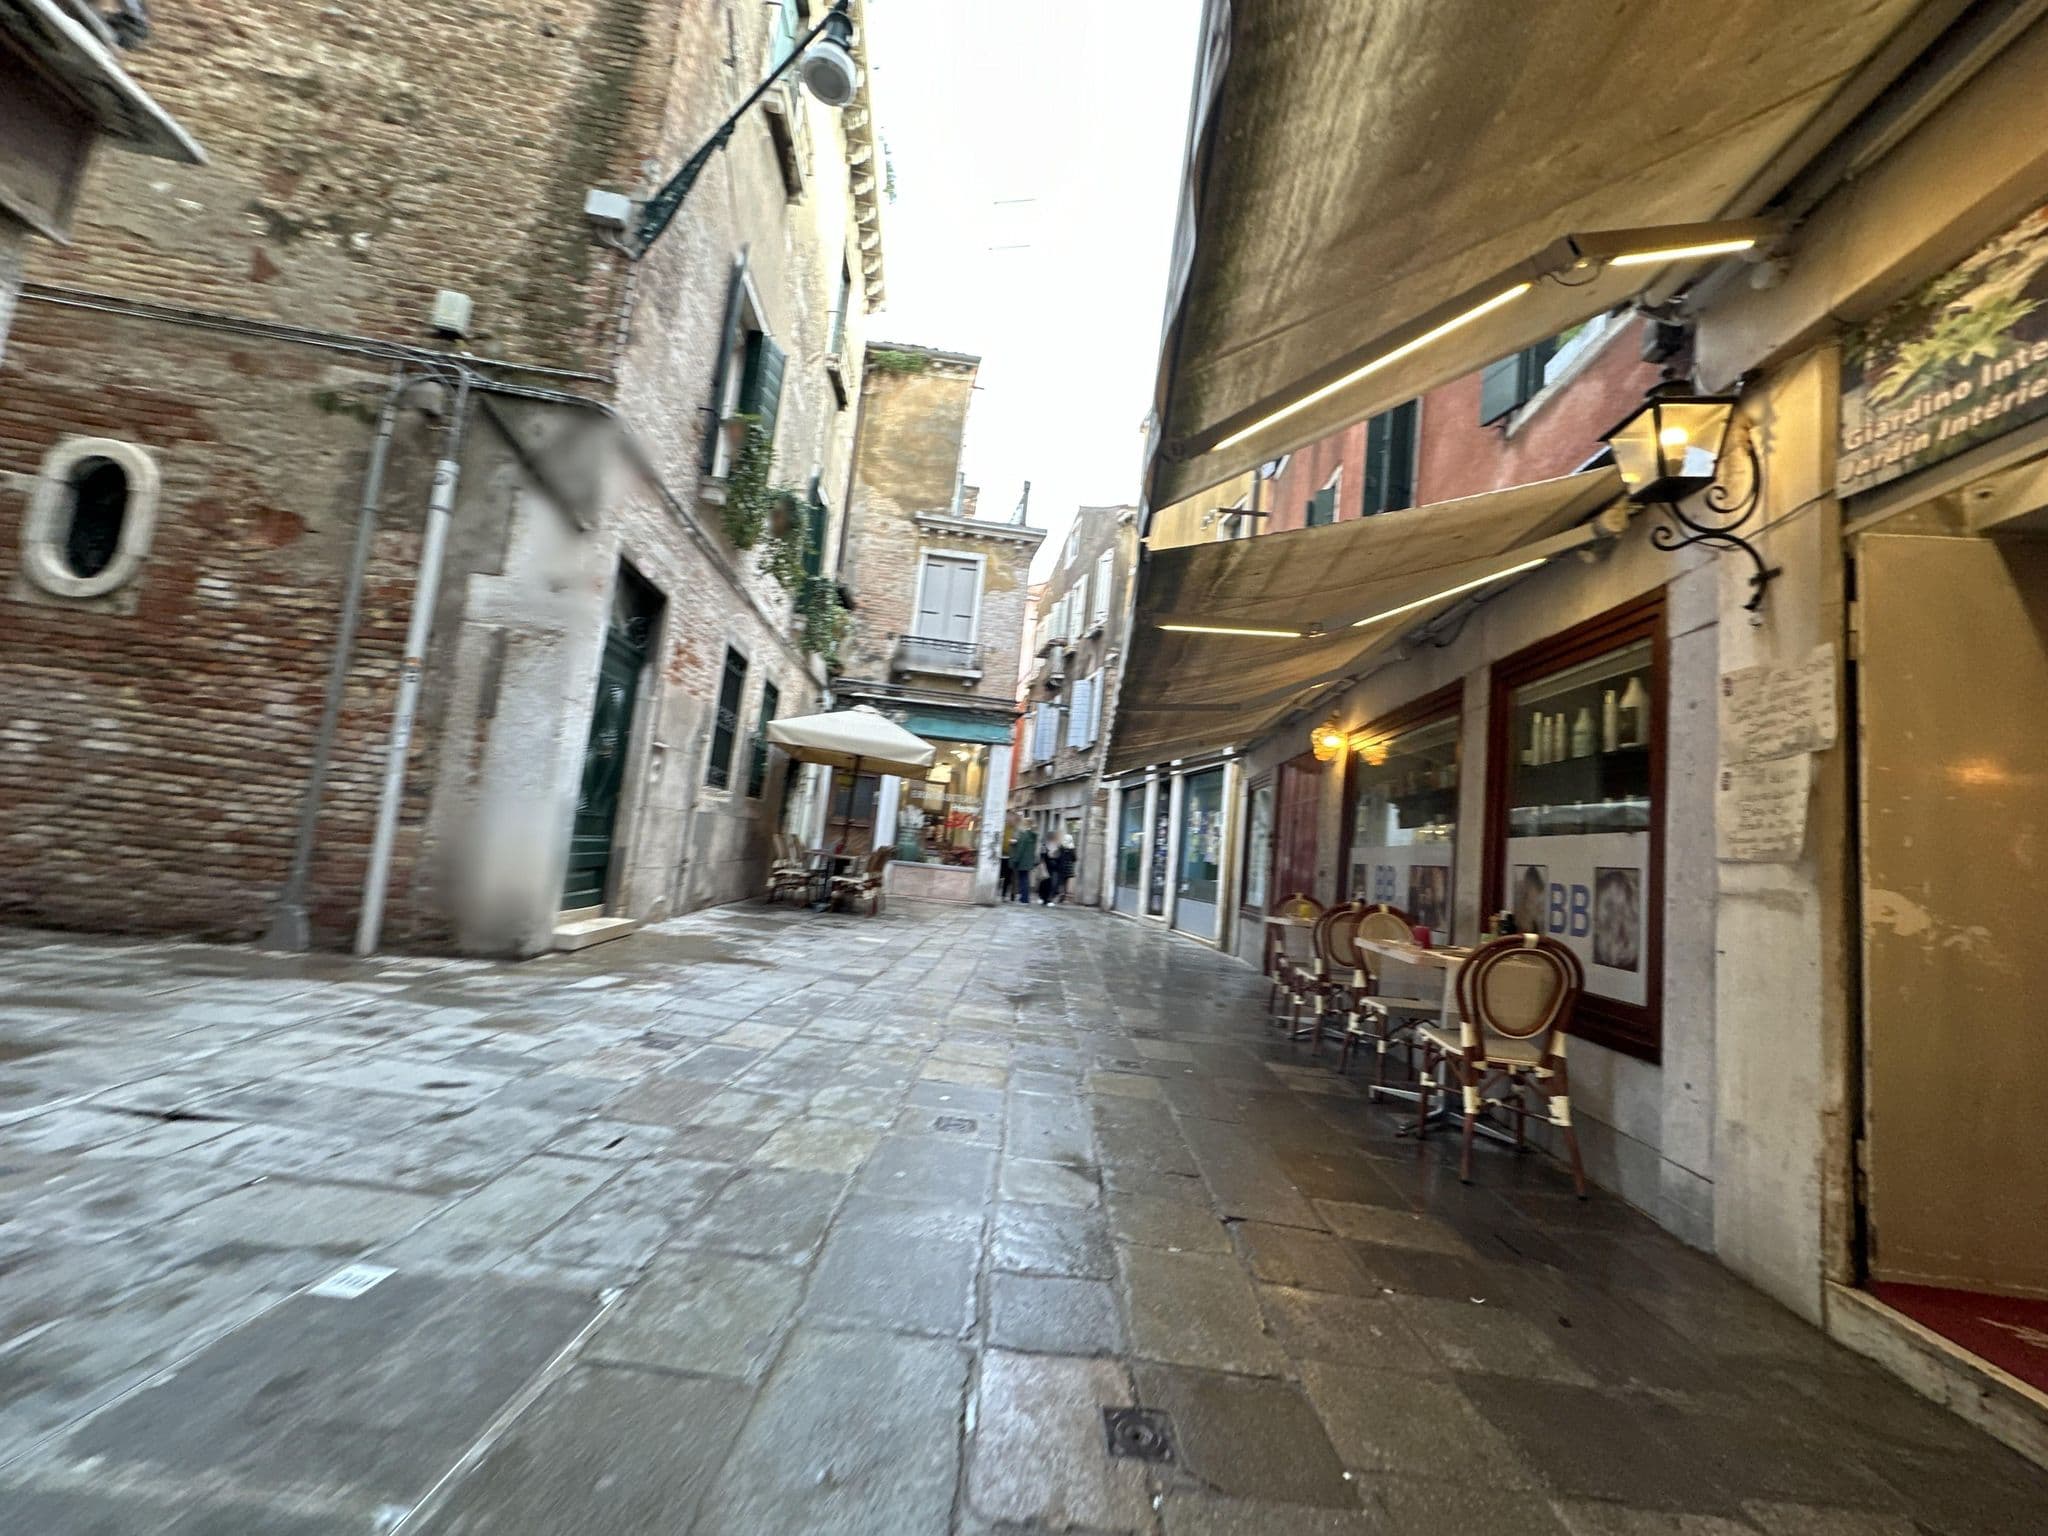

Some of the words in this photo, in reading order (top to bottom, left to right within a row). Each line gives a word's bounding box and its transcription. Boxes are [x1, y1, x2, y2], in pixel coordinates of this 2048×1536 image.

[1845, 380, 1973, 450] Giardino
[1839, 432, 1931, 483] Jardin
[1550, 882, 1589, 937] BB
